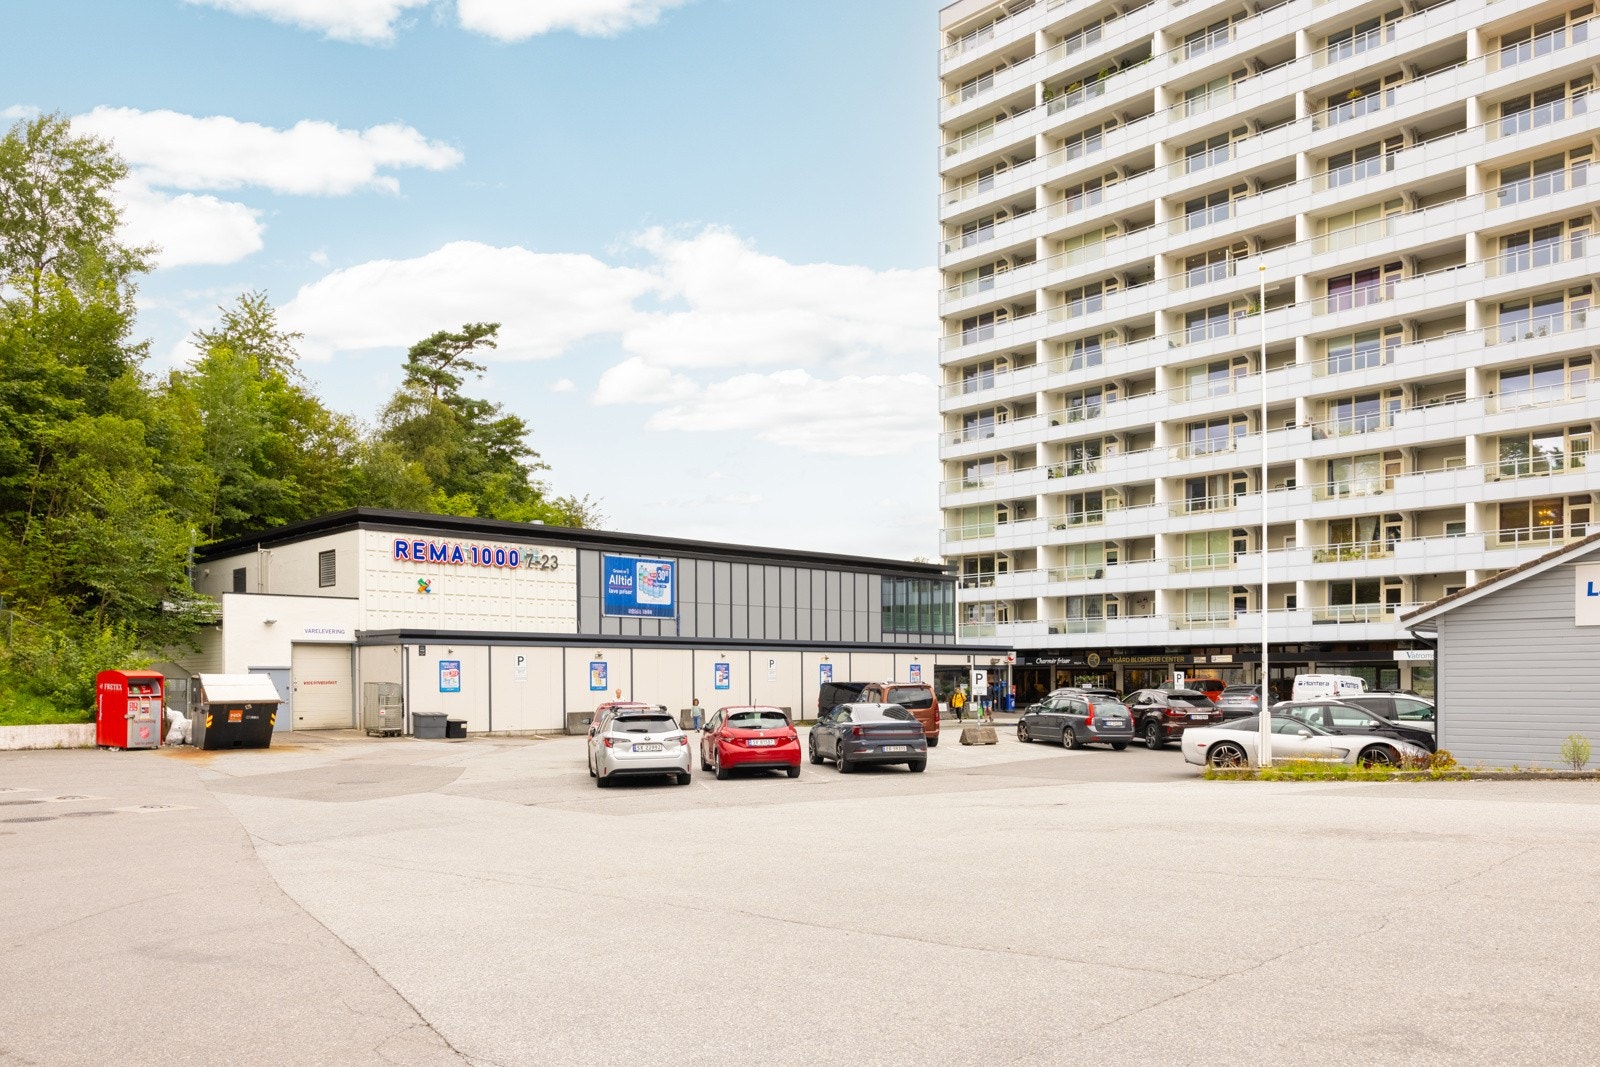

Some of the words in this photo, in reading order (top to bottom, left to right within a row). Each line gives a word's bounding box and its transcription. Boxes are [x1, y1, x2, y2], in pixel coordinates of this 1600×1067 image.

[394, 539, 465, 564] REMA
[470, 545, 521, 569] 1000
[526, 554, 559, 570] 7-23
[608, 574, 633, 586] Alltid
[517, 656, 525, 666] P
[769, 659, 775, 668] P
[975, 673, 983, 684] P
[1176, 673, 1182, 683] P
